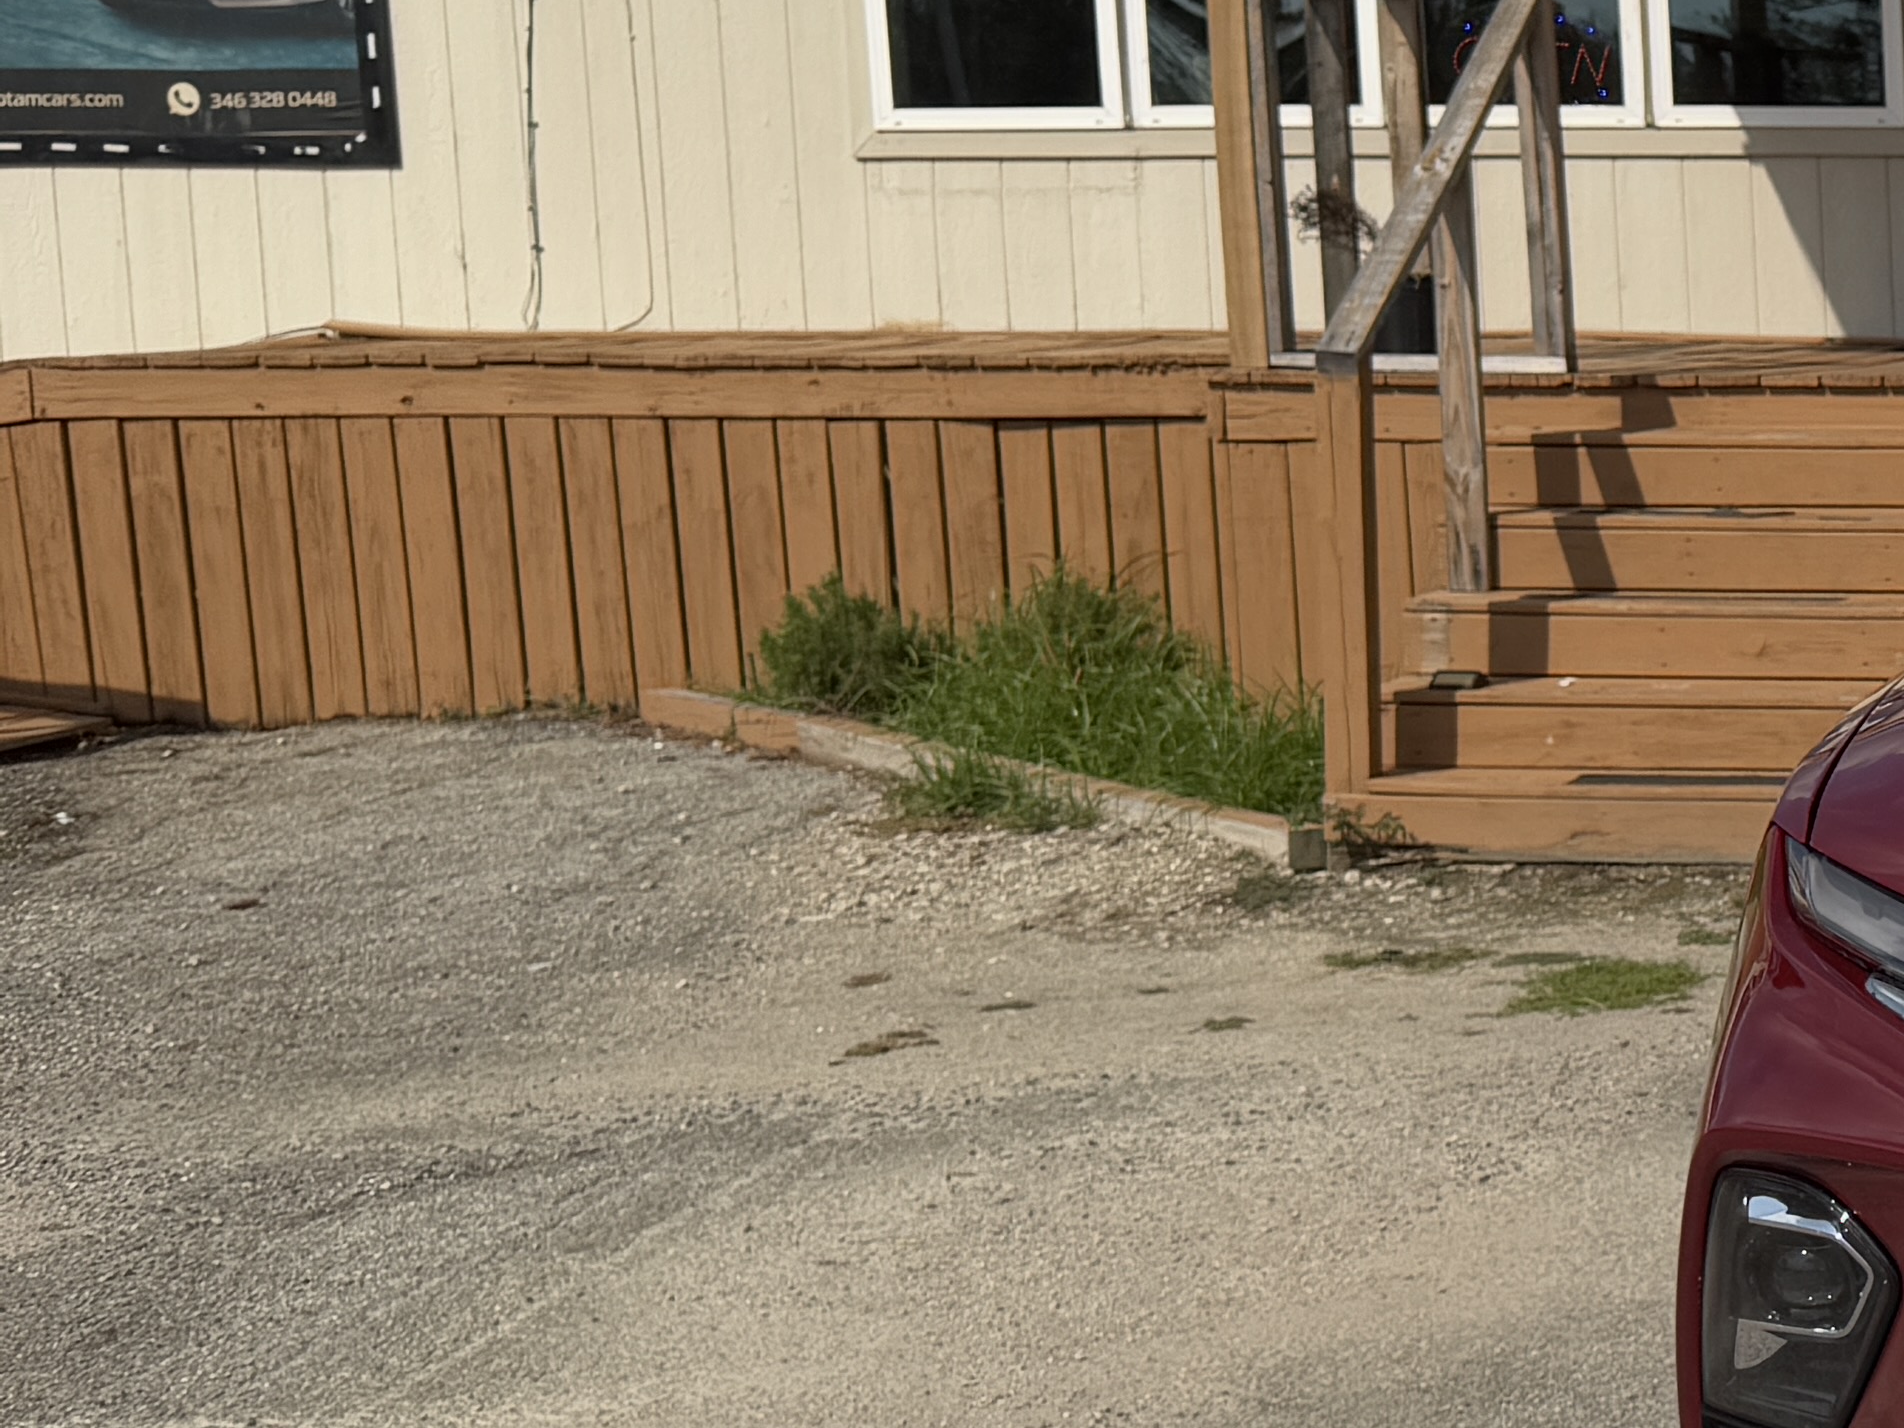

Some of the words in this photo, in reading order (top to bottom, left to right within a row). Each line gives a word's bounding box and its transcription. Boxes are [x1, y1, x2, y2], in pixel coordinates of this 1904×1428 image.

[210, 92, 247, 109] 346
[249, 91, 285, 108] 328
[287, 91, 337, 108] 0448
